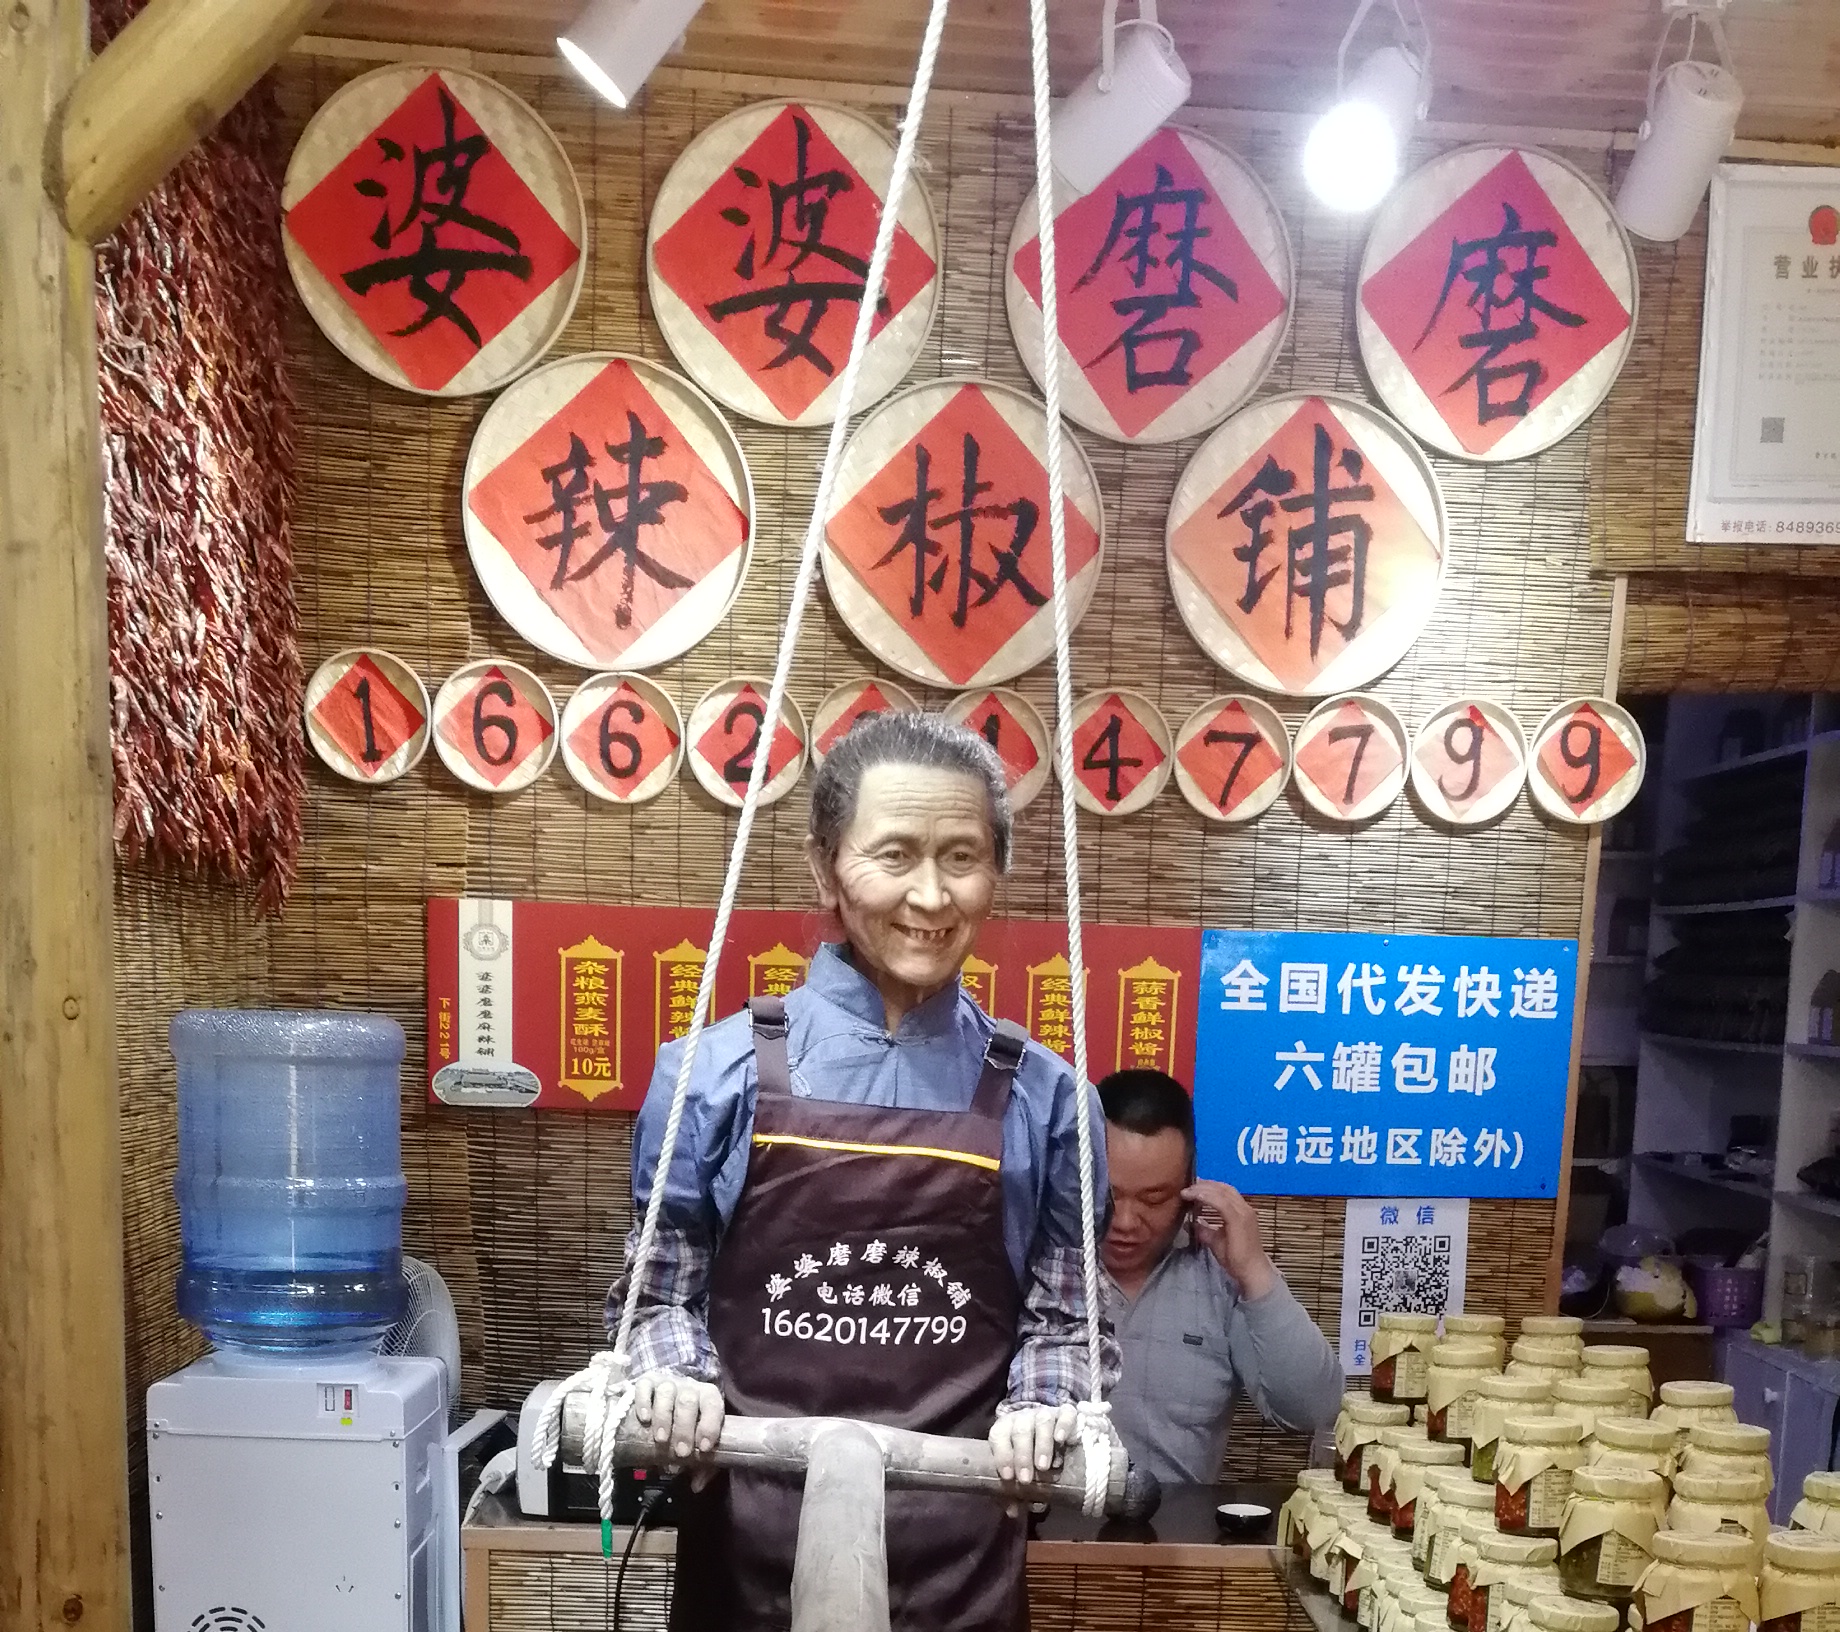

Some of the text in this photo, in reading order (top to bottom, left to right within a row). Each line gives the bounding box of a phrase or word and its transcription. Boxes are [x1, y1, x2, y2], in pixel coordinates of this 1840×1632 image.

[340, 86, 1587, 427] 婆婆磨磨
[523, 410, 1376, 664] 辣椒铺
[355, 676, 1603, 807] 166247799
[1220, 959, 1559, 1020] 全国代发快递
[571, 1057, 612, 1078] 10元
[1273, 1041, 1498, 1096] 六罐包邮
[1236, 1124, 1524, 1170] (偏远地区除外)
[1379, 1205, 1436, 1226] 微信
[816, 1281, 922, 1307] 电话微信
[761, 1307, 967, 1345] 16620147799
